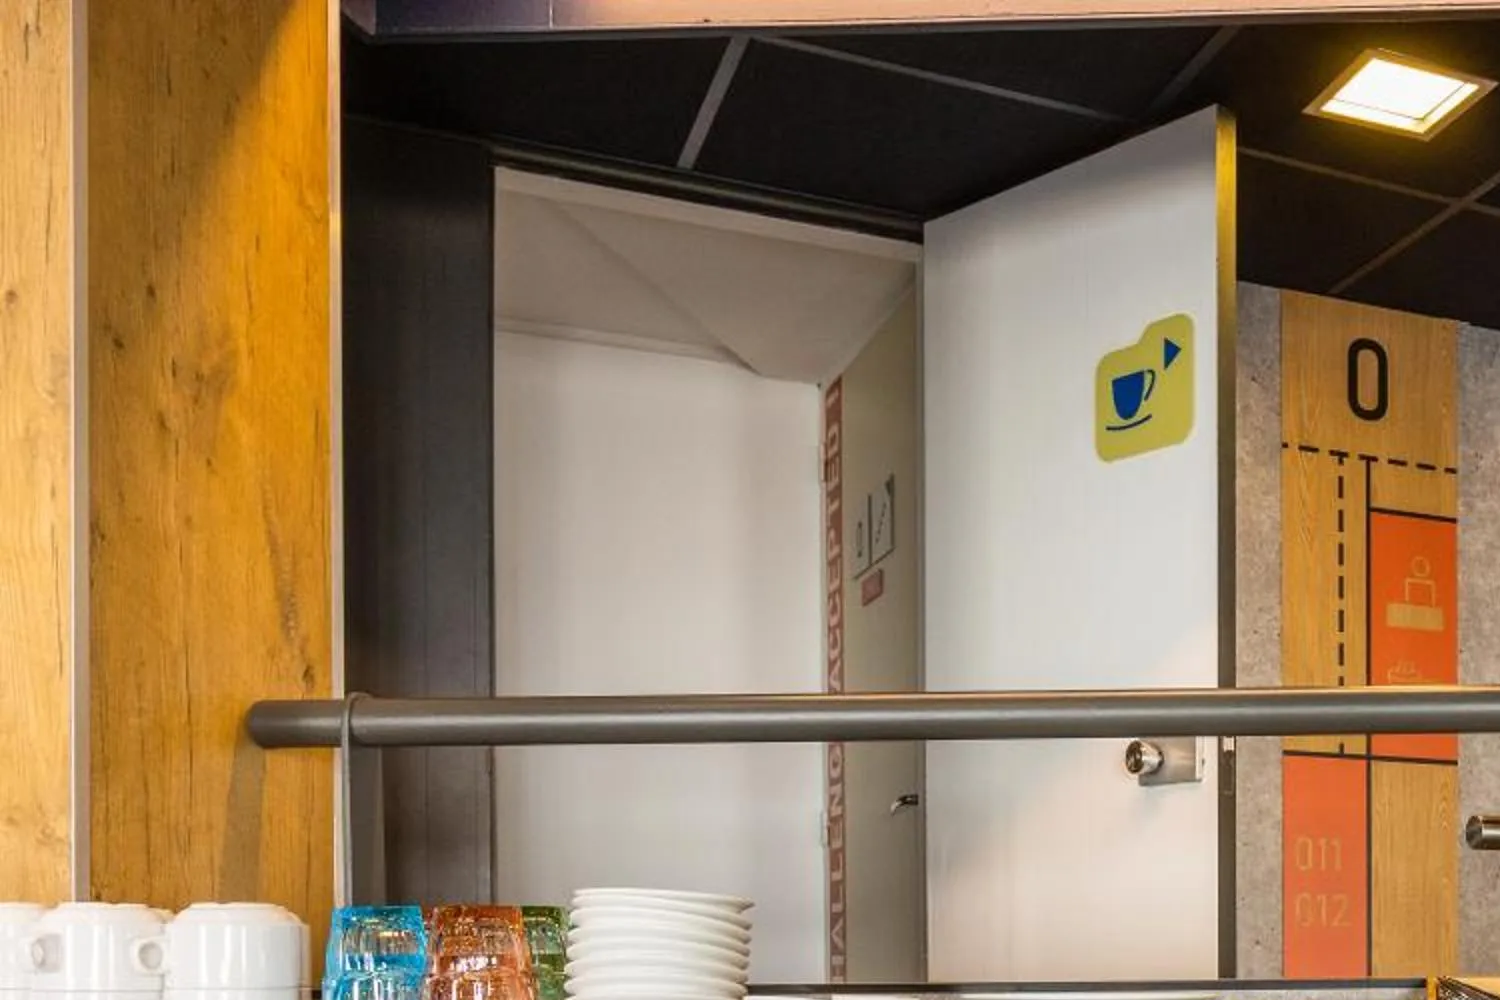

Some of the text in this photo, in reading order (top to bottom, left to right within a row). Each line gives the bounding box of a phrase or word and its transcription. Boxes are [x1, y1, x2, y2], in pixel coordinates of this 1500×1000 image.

[1347, 338, 1388, 421] 0
[827, 423, 842, 692] ACCEPTED
[1295, 837, 1342, 871] 011
[1295, 893, 1352, 927] 012
